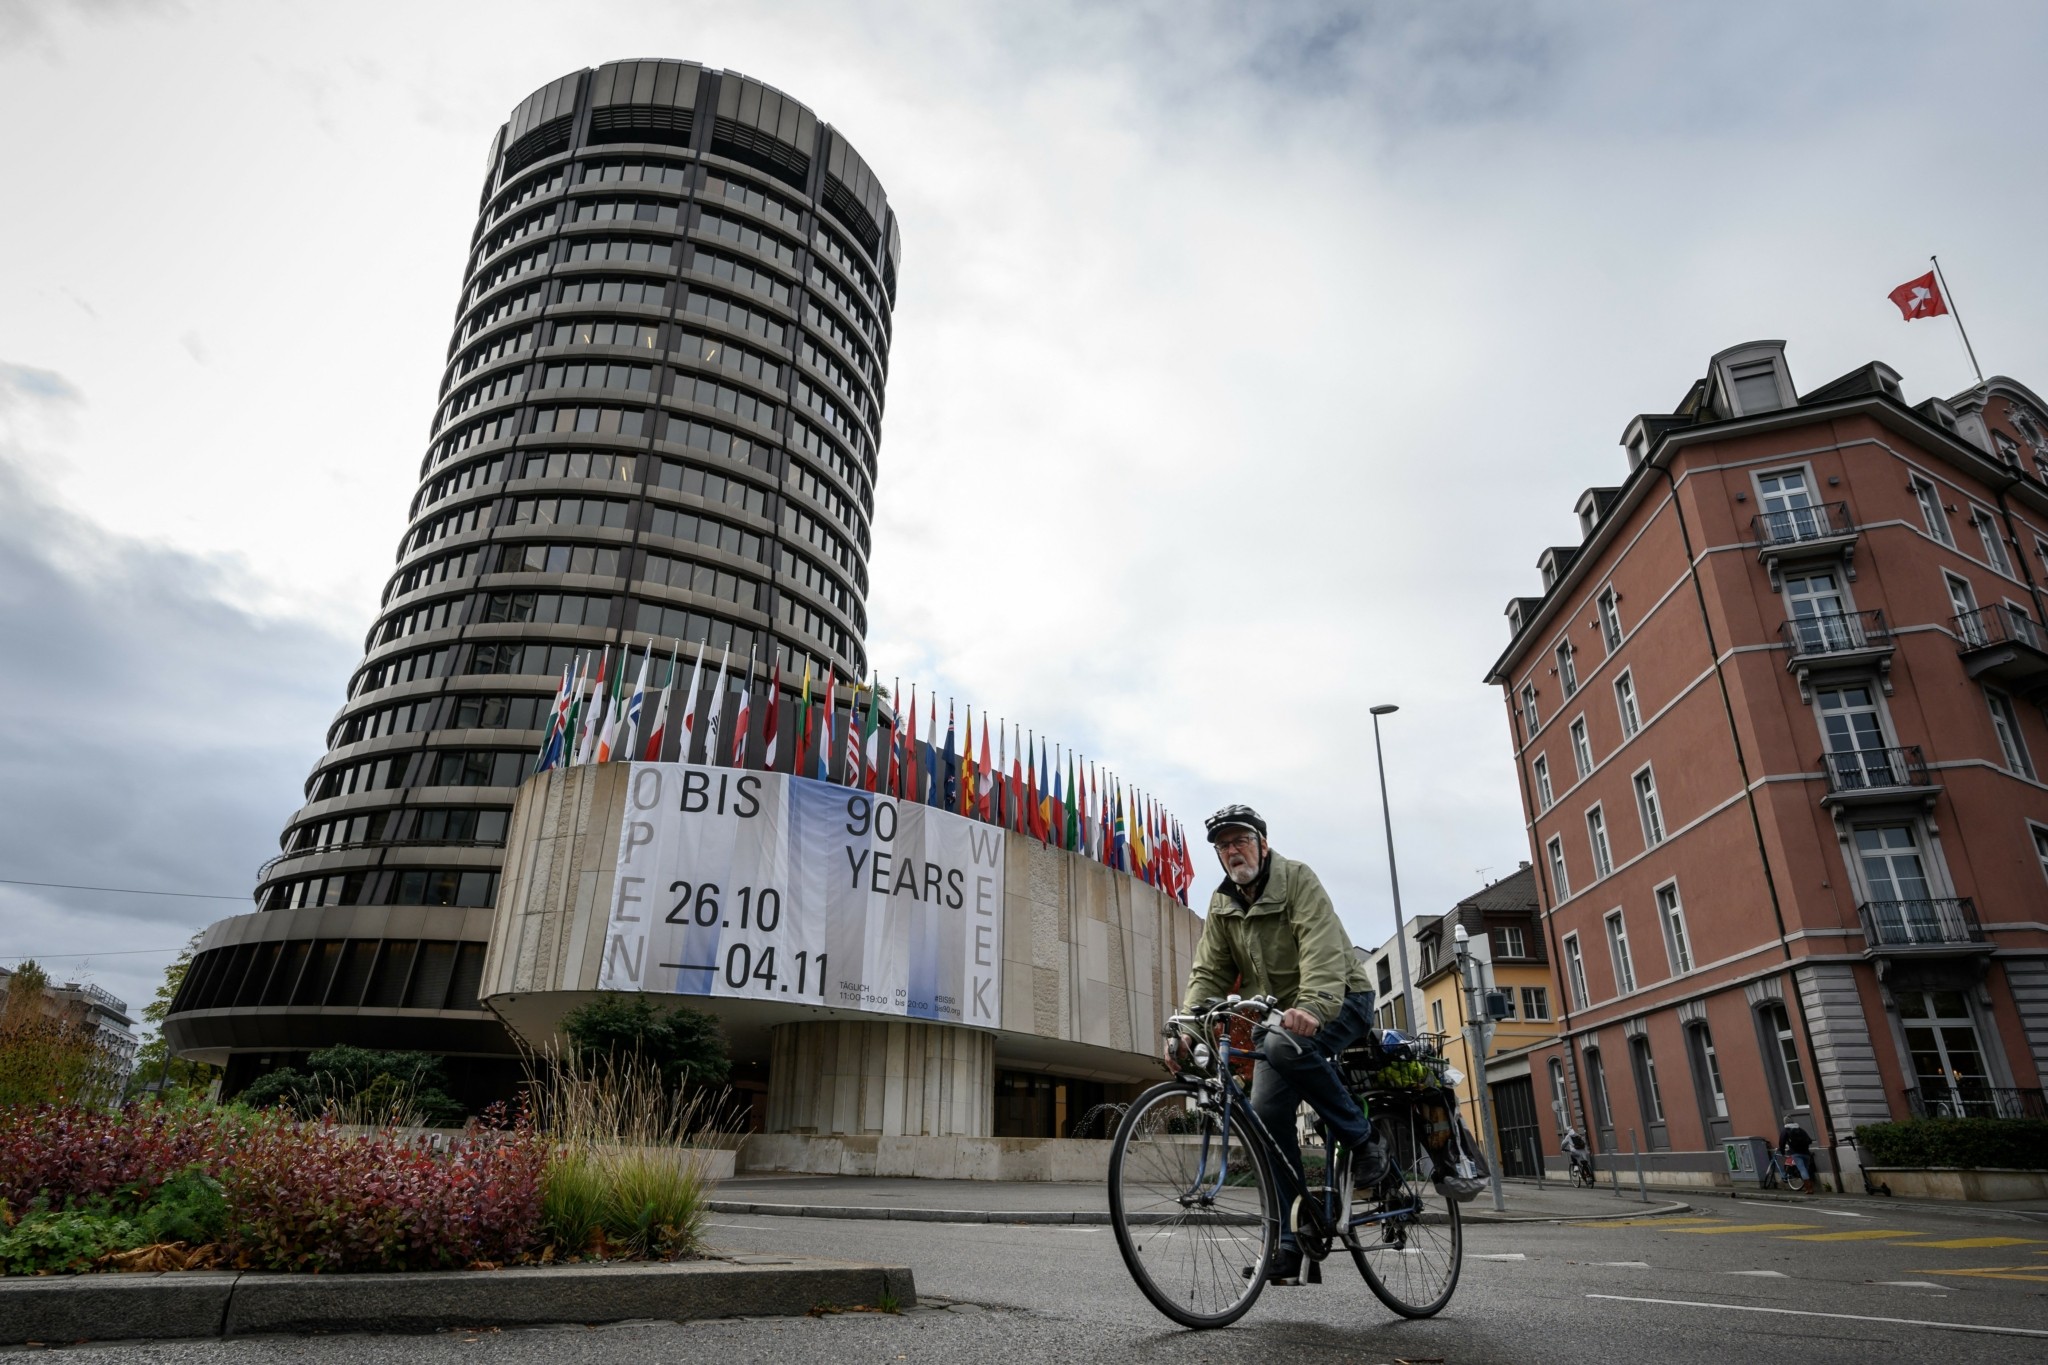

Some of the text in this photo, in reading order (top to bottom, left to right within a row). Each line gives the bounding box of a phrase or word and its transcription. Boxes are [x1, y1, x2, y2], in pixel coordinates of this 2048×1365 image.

[680, 770, 762, 819] BIS
[846, 795, 898, 843] 90
[607, 767, 662, 982] OPEN
[845, 845, 964, 910] YEARS
[665, 880, 780, 932] 26.10
[968, 824, 1000, 1020] WEEK
[840, 981, 870, 992] TÄGLICH
[895, 988, 907, 998] DO
[895, 998, 928, 1010] bis 20:00
[935, 995, 956, 1005] #BIS90
[935, 1004, 961, 1016] bis90.org
